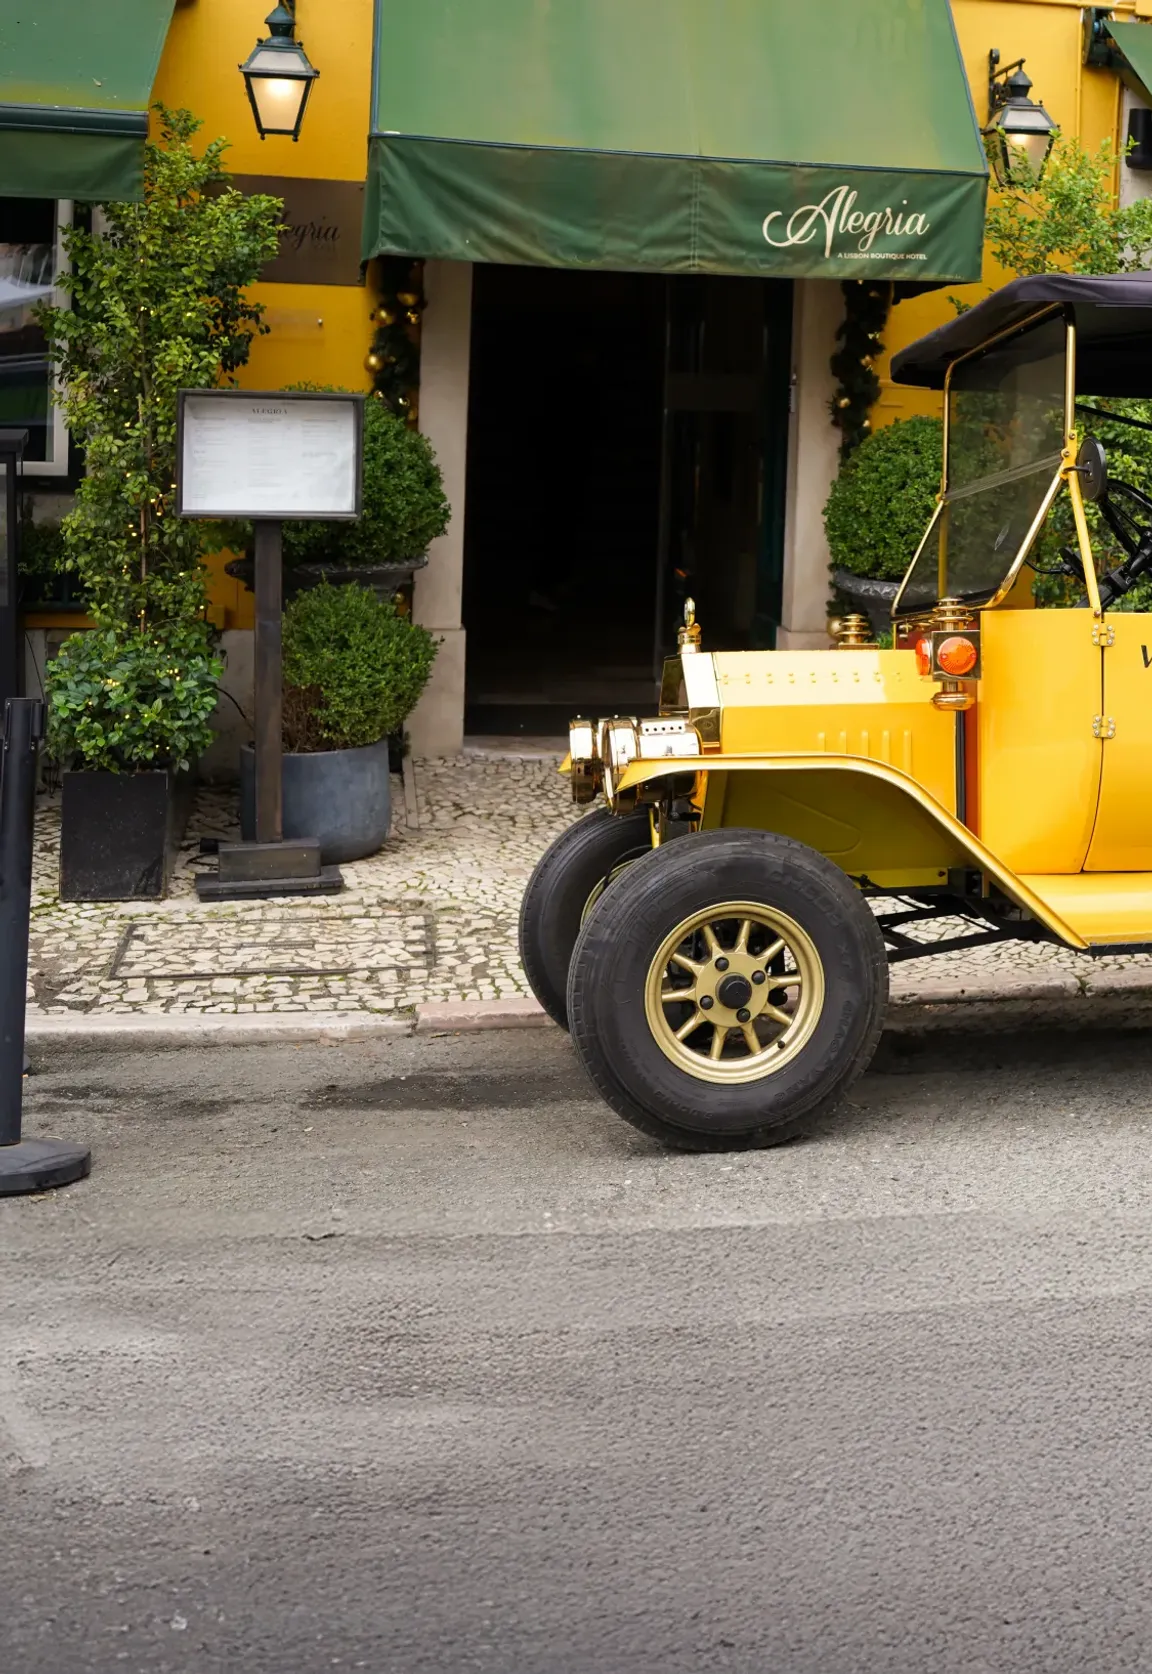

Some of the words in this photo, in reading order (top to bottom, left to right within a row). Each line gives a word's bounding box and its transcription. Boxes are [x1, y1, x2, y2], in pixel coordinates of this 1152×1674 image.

[273, 210, 341, 249] legria
[762, 185, 930, 259] Alegria
[844, 252, 870, 260] LISBON
[870, 252, 905, 260] BOUTIQUE
